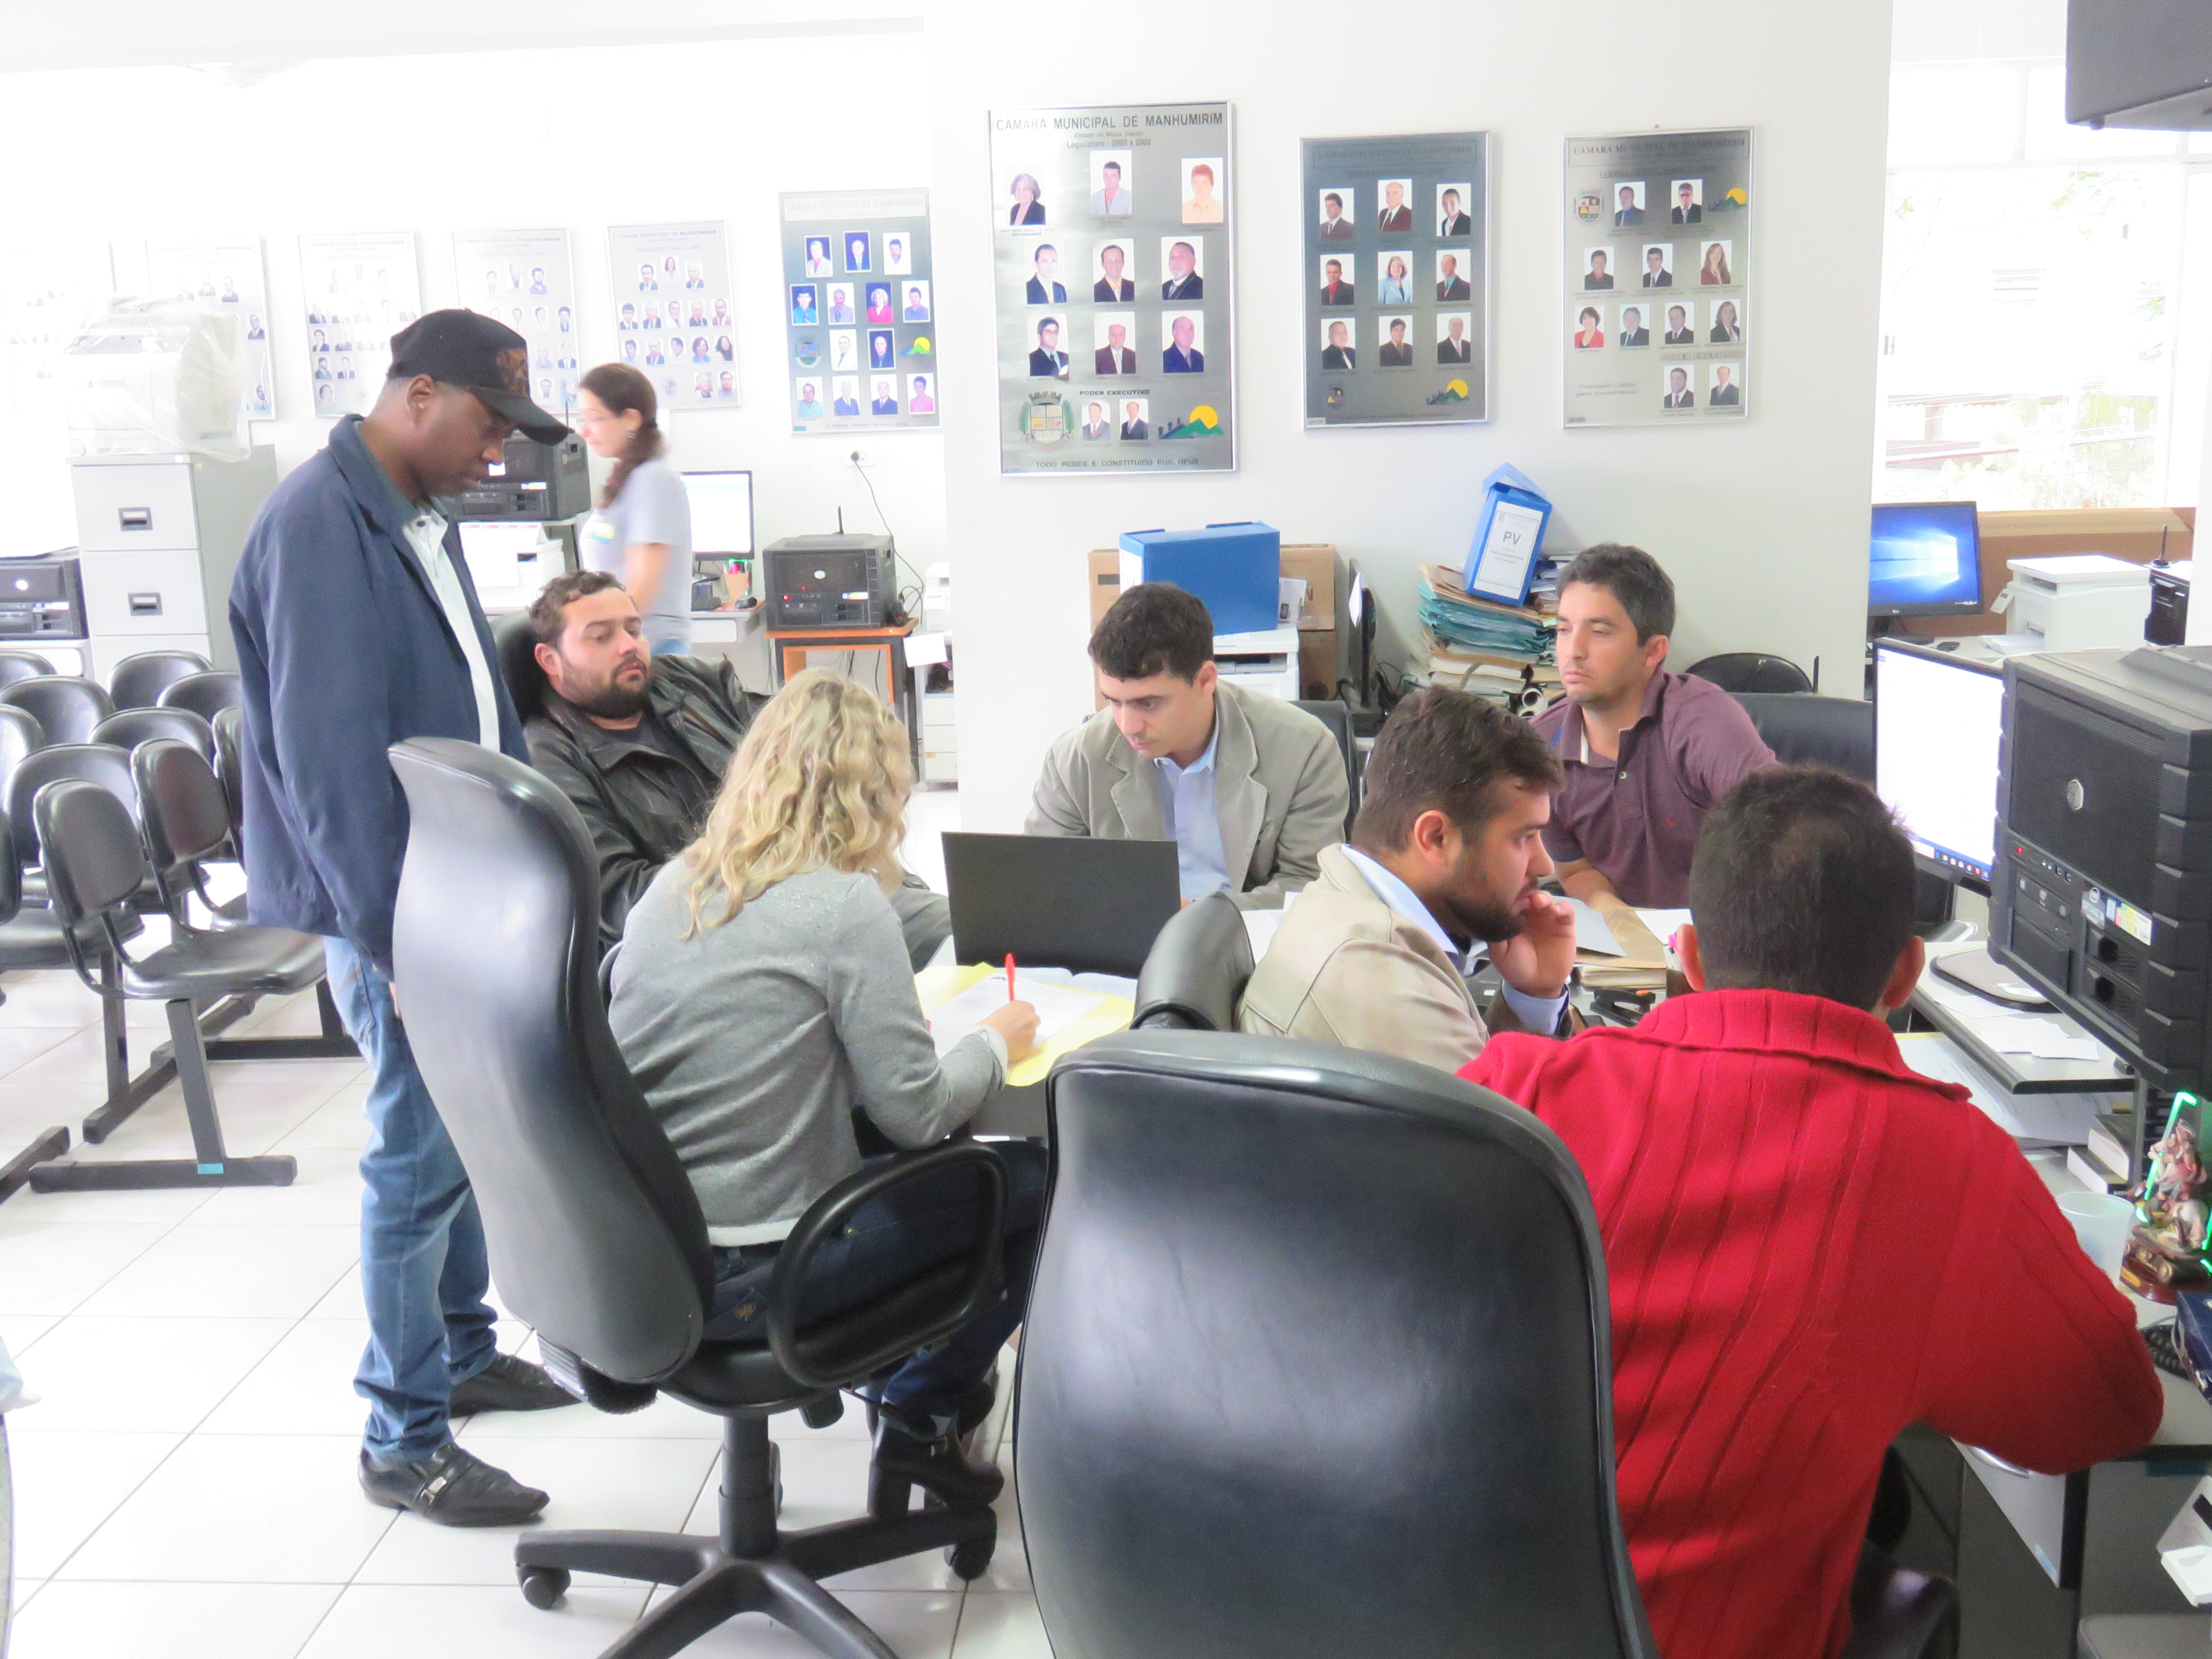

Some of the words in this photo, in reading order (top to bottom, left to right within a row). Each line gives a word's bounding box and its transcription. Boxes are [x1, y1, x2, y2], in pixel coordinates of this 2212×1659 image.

[1054, 116, 1116, 130] MUNICIPAL
[1123, 115, 1138, 127] DE
[1146, 112, 1223, 126] MANHUMIRIM
[1067, 140, 1105, 150] Legislatura
[872, 198, 924, 208] MANHUMIRIM
[1503, 530, 1522, 545] PV
